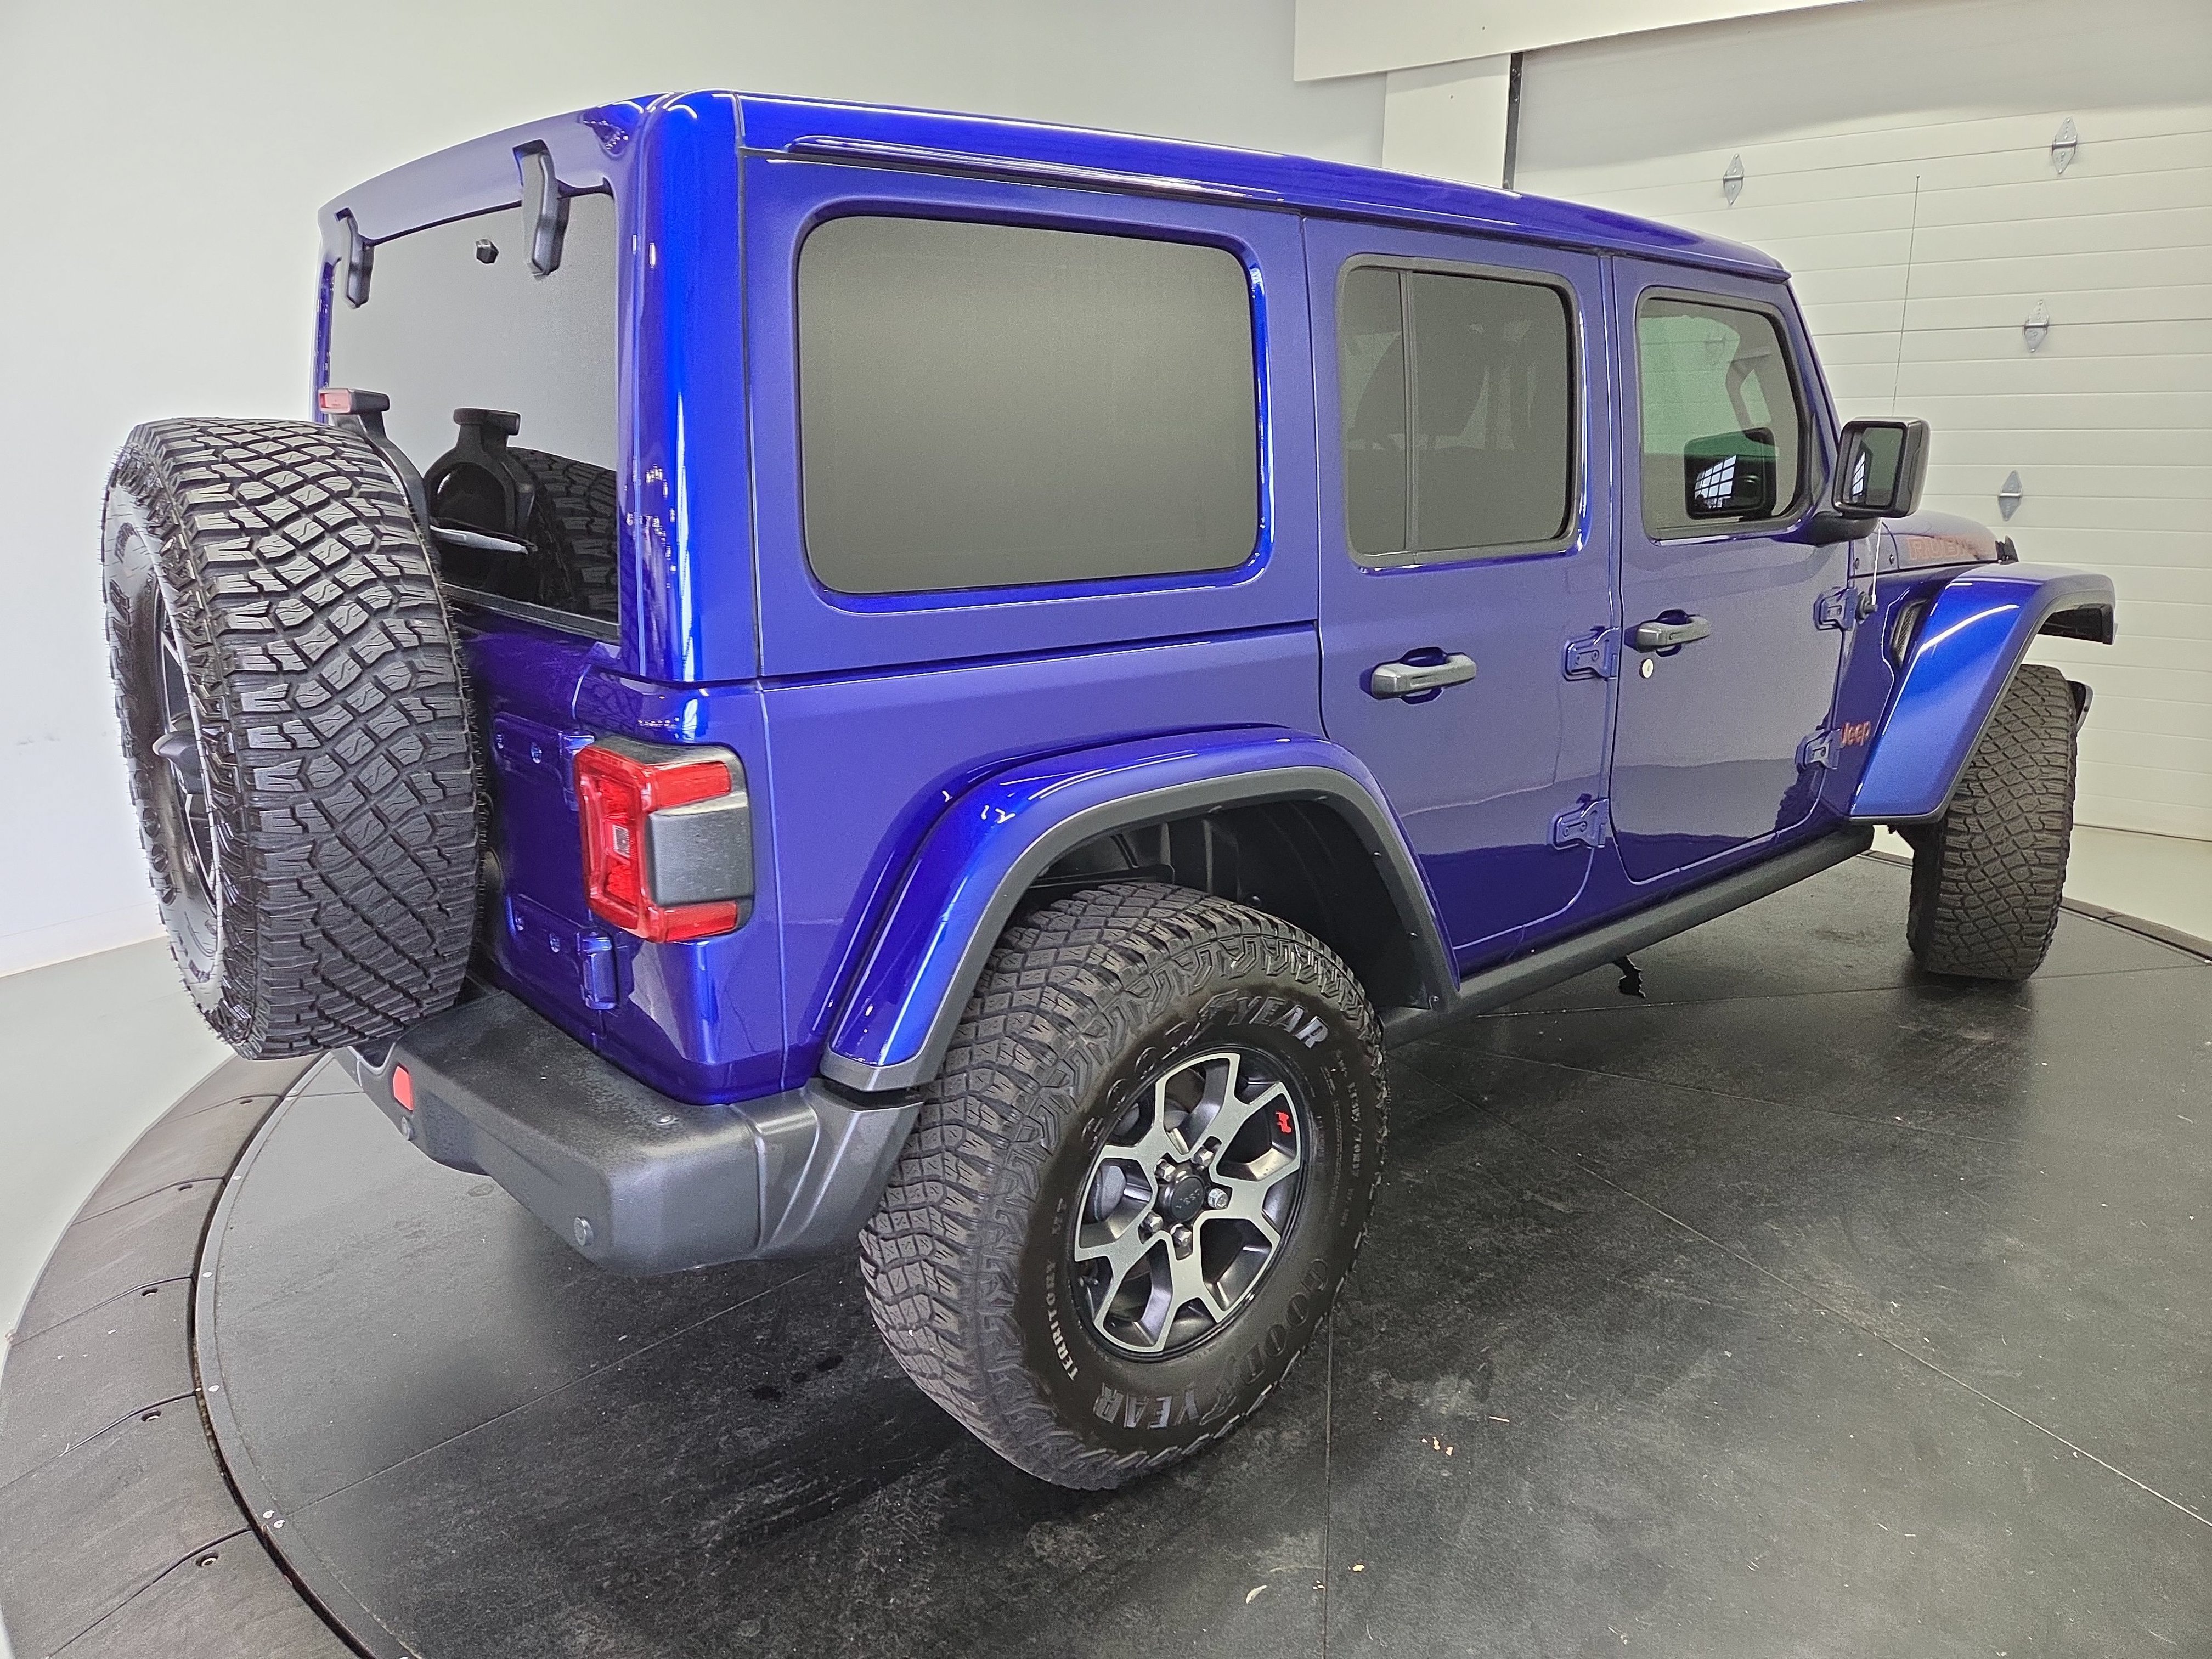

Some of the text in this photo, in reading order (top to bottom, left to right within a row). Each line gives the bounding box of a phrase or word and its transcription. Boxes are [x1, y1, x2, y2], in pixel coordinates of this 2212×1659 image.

[1842, 721, 1871, 747] Jeep
[1227, 996, 1329, 1049] YEAR
[1046, 1260, 1079, 1381] TERRITORY
[1093, 1381, 1200, 1429] YEAR
